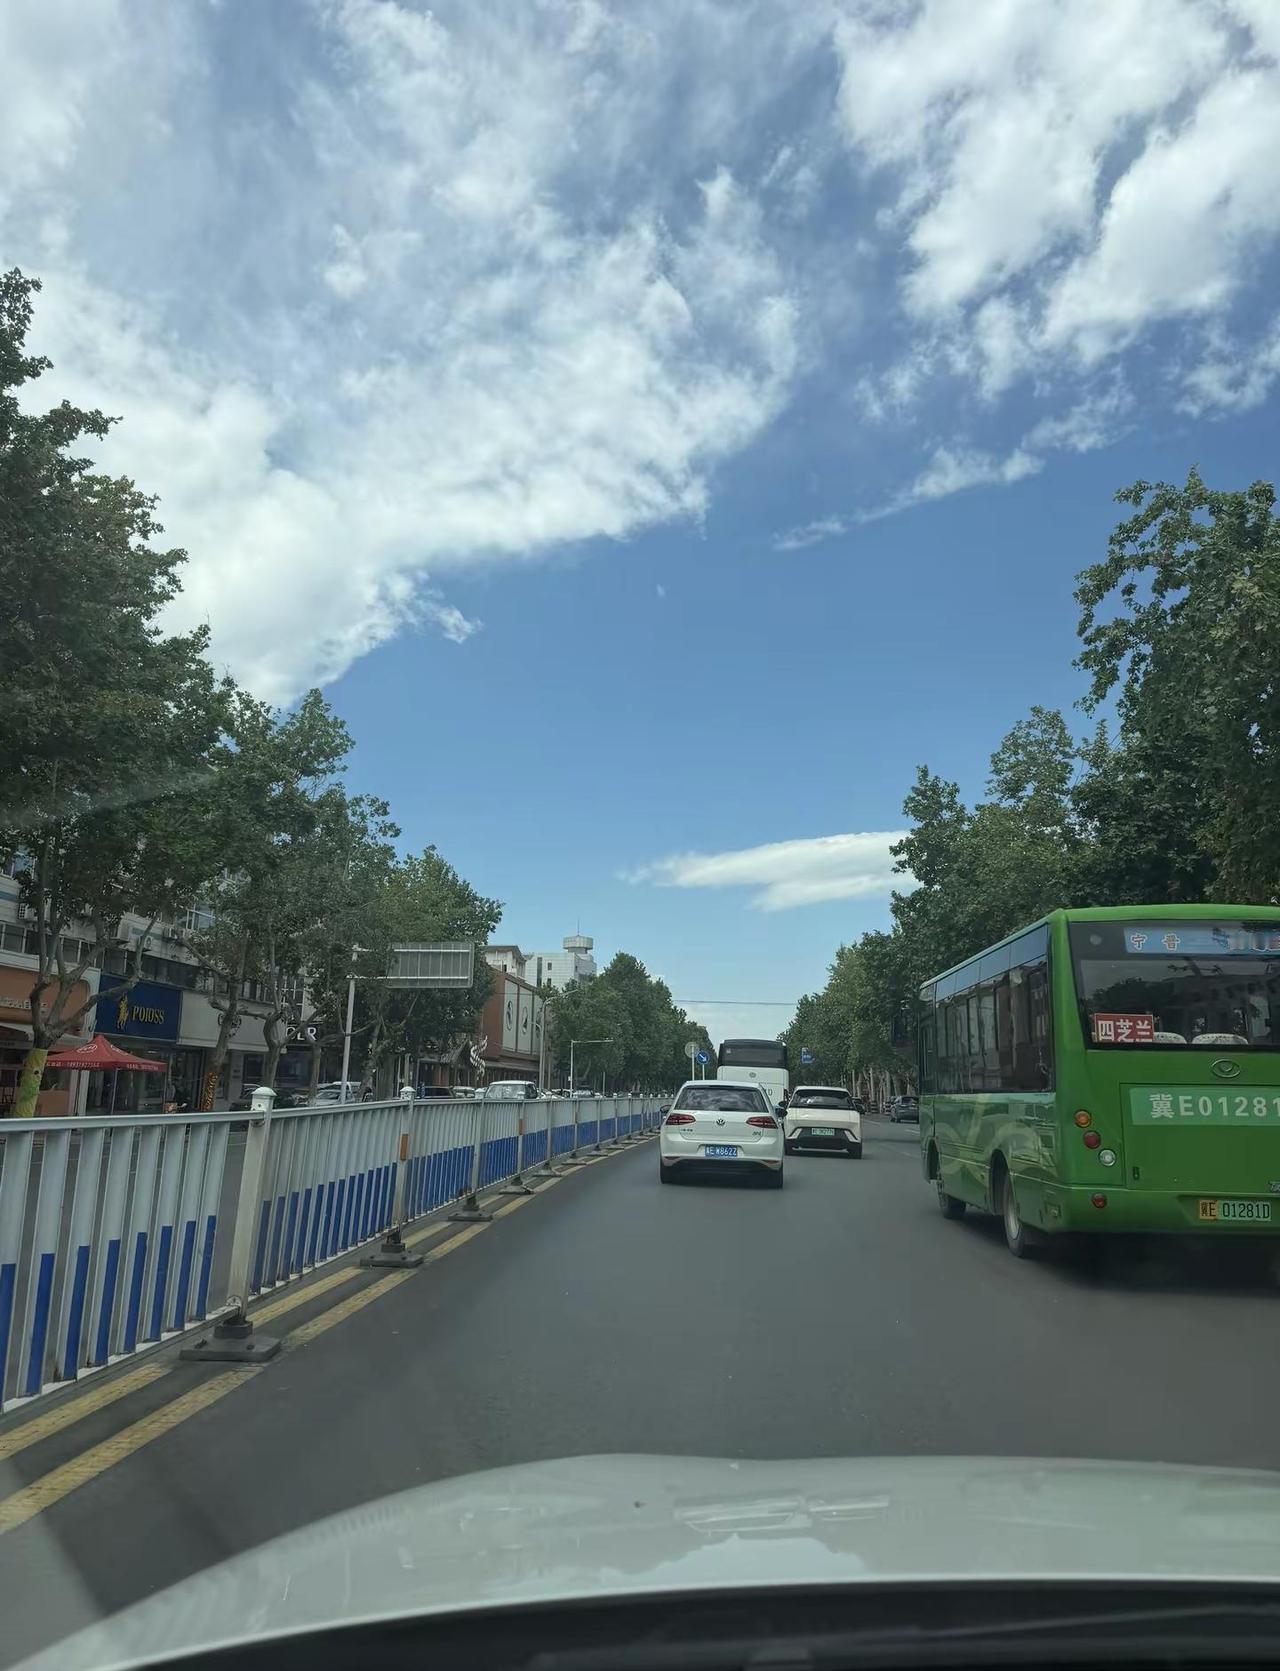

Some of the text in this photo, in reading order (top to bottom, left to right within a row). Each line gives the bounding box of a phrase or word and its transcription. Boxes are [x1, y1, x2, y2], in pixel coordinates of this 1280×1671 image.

[1098, 1019, 1153, 1042] 四芝兰
[1222, 1202, 1270, 1219] 01281D
